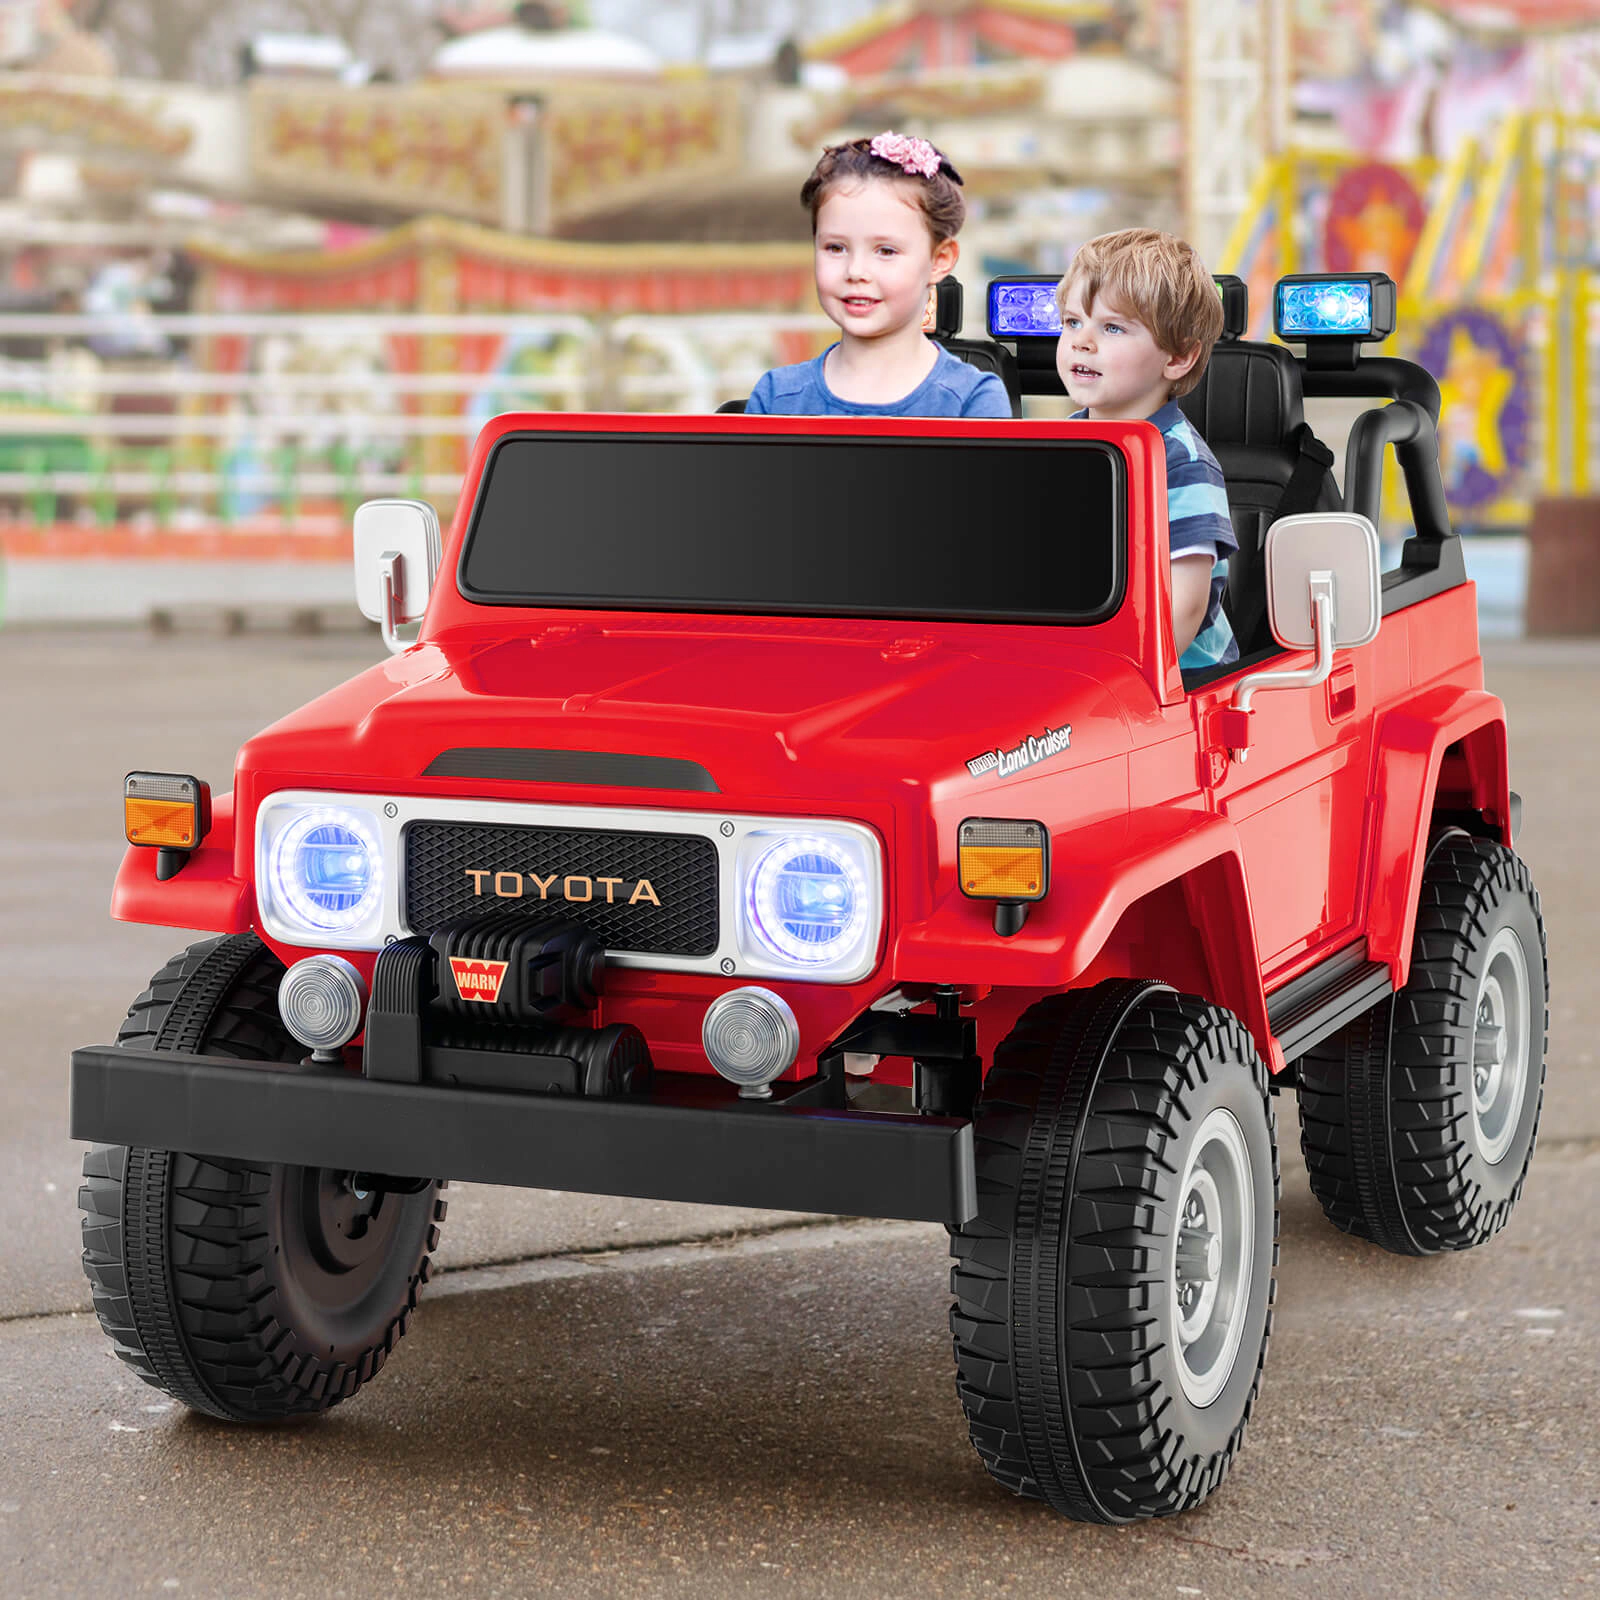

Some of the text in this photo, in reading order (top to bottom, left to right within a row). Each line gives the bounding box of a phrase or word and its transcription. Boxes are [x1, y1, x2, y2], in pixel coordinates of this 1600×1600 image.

[997, 742, 1028, 776] Land
[1028, 725, 1072, 762] Cruiser
[465, 869, 661, 906] TOYOTA
[457, 971, 497, 990] WARN
